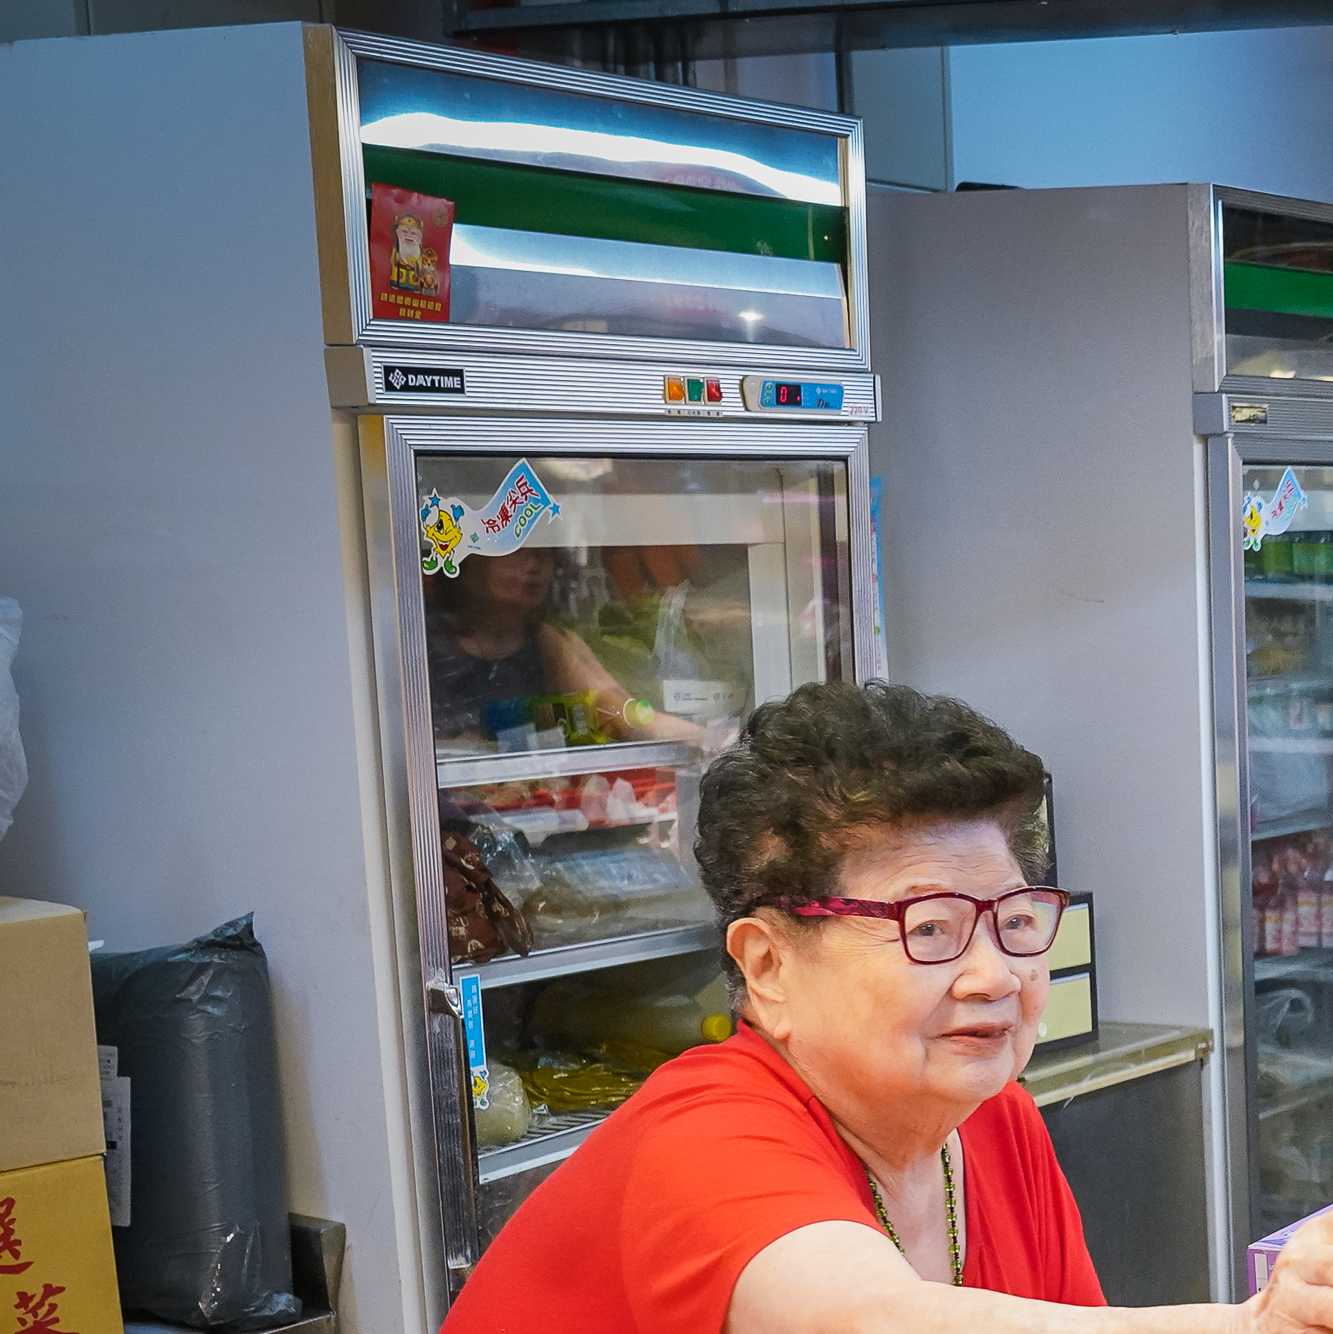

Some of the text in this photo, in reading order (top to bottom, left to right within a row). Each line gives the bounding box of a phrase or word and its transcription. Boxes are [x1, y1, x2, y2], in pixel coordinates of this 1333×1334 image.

[408, 374, 461, 389] DAYTIME
[481, 474, 540, 535] 冷凍尖兵
[513, 502, 543, 539] COOL
